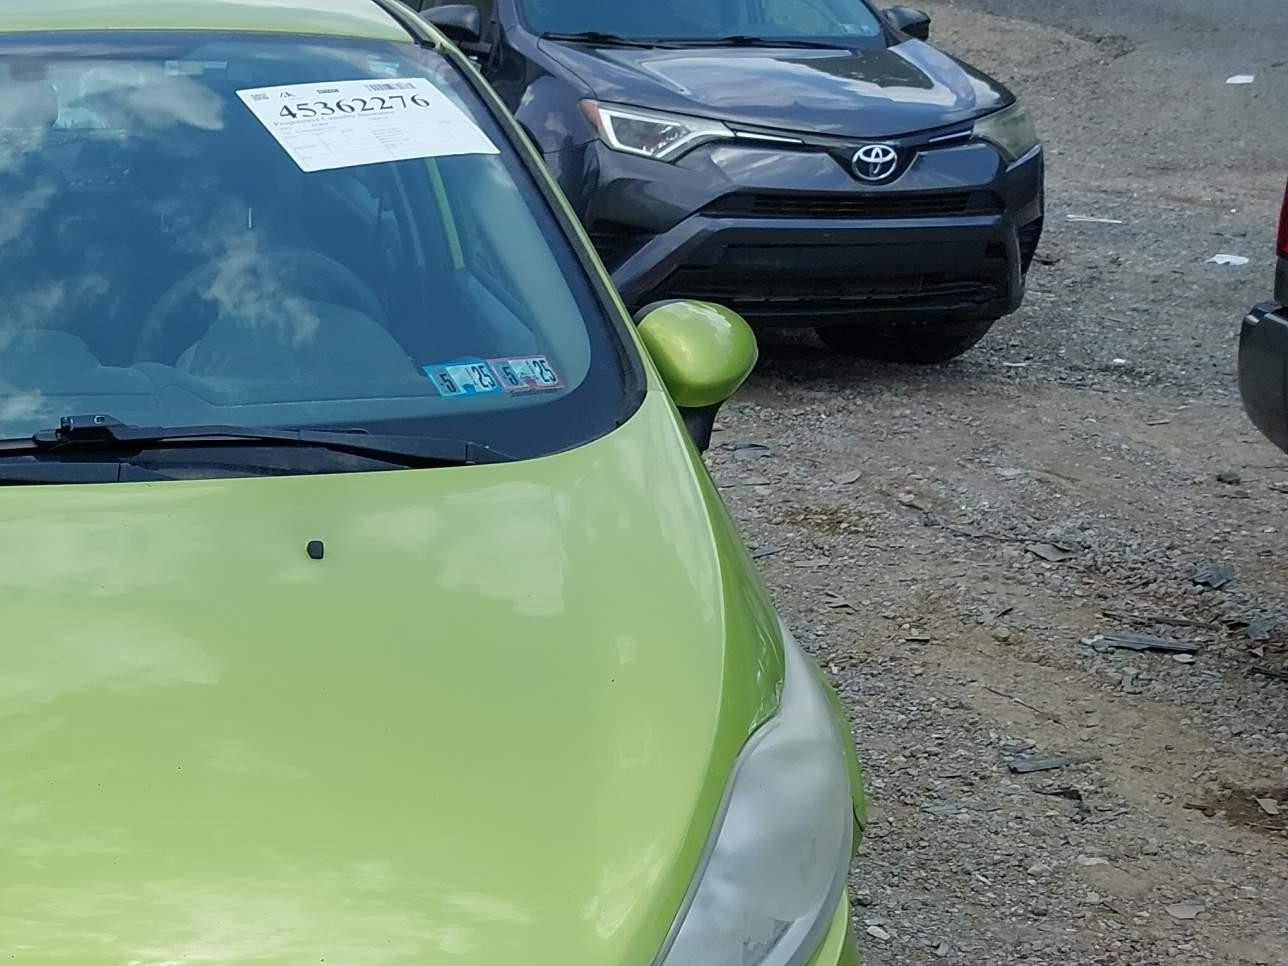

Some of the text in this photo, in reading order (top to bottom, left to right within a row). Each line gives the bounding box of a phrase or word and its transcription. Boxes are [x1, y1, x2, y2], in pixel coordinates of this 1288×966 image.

[278, 94, 431, 118] 45362276
[472, 365, 496, 388] 25
[532, 360, 557, 383] 25
